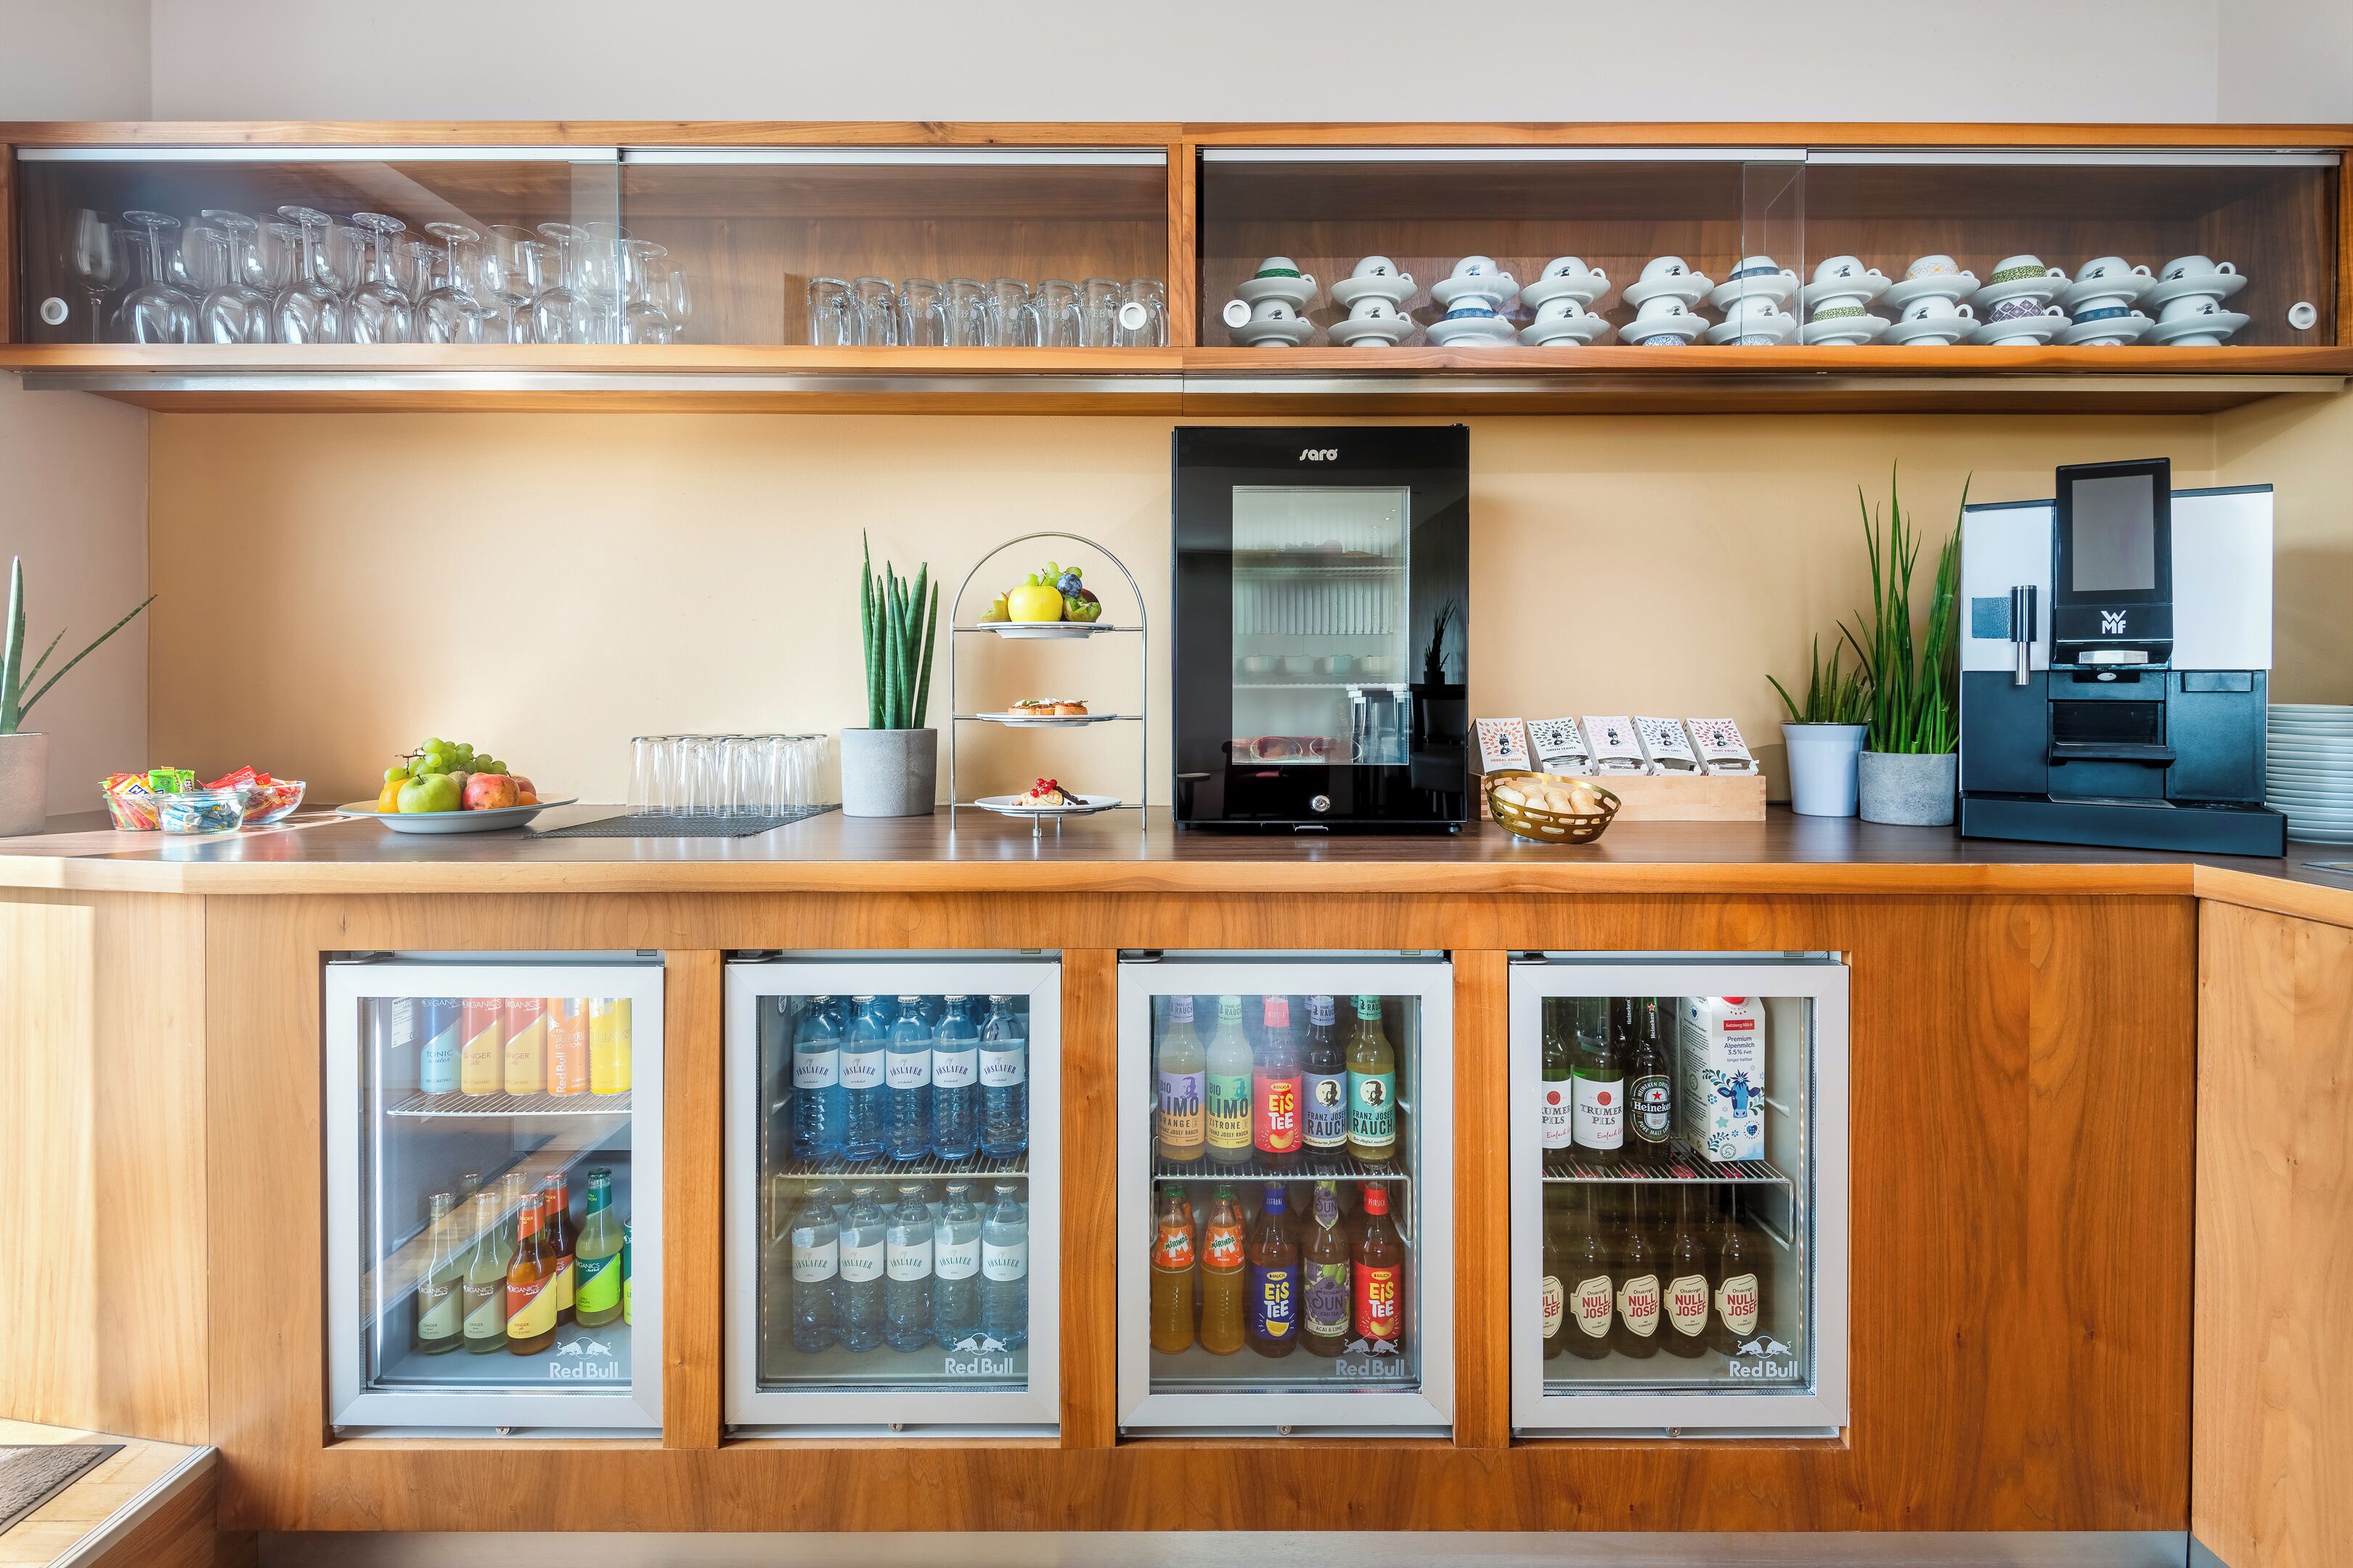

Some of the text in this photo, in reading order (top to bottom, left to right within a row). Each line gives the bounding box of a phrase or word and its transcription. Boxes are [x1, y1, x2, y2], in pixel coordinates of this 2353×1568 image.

[1300, 449, 1338, 461] saro
[423, 997, 458, 1008] ORGANIC
[463, 998, 502, 1008] ORGANICS
[505, 999, 540, 1008] ORGANICS
[426, 1049, 453, 1058] TONIC
[1160, 1080, 1172, 1094] BIO
[1209, 1082, 1221, 1096] BIO
[1637, 1082, 1657, 1097] HEINEKEN
[1160, 1093, 1199, 1117] LIMO
[1209, 1096, 1249, 1119] LIMO
[1542, 1105, 1571, 1115] UMER
[1580, 1103, 1622, 1116] TRUMER
[1308, 1111, 1328, 1122] FRANZ
[1353, 1109, 1392, 1121] FRANZ JOSEF
[1542, 1116, 1565, 1124] PILS
[1592, 1116, 1615, 1125] PILS
[1209, 1117, 1240, 1130] ZITRONE
[1308, 1118, 1347, 1136] RAUCH
[1353, 1118, 1392, 1135] RAUCH
[1638, 1121, 1649, 1133] PURE
[1209, 1128, 1220, 1137] FRANZ
[1316, 1199, 1337, 1213] SUN
[463, 1285, 494, 1294] ORGANICS
[507, 1284, 539, 1293] ORGANICS
[1312, 1290, 1343, 1311] SUN
[1582, 1294, 1607, 1308] NULL
[1628, 1293, 1656, 1307] NULL
[1675, 1292, 1702, 1306] NULL
[1727, 1292, 1755, 1305] NULL
[1583, 1301, 1611, 1319] JOSEF
[1629, 1300, 1658, 1318] JOSEF
[1676, 1300, 1706, 1316] JOSEF
[1728, 1299, 1757, 1316] JOSEF
[550, 1361, 619, 1379] Red Bull
[945, 1357, 1014, 1374] Red Bull
[1336, 1359, 1405, 1376] Red Bull
[1729, 1360, 1798, 1378] Red Bull
